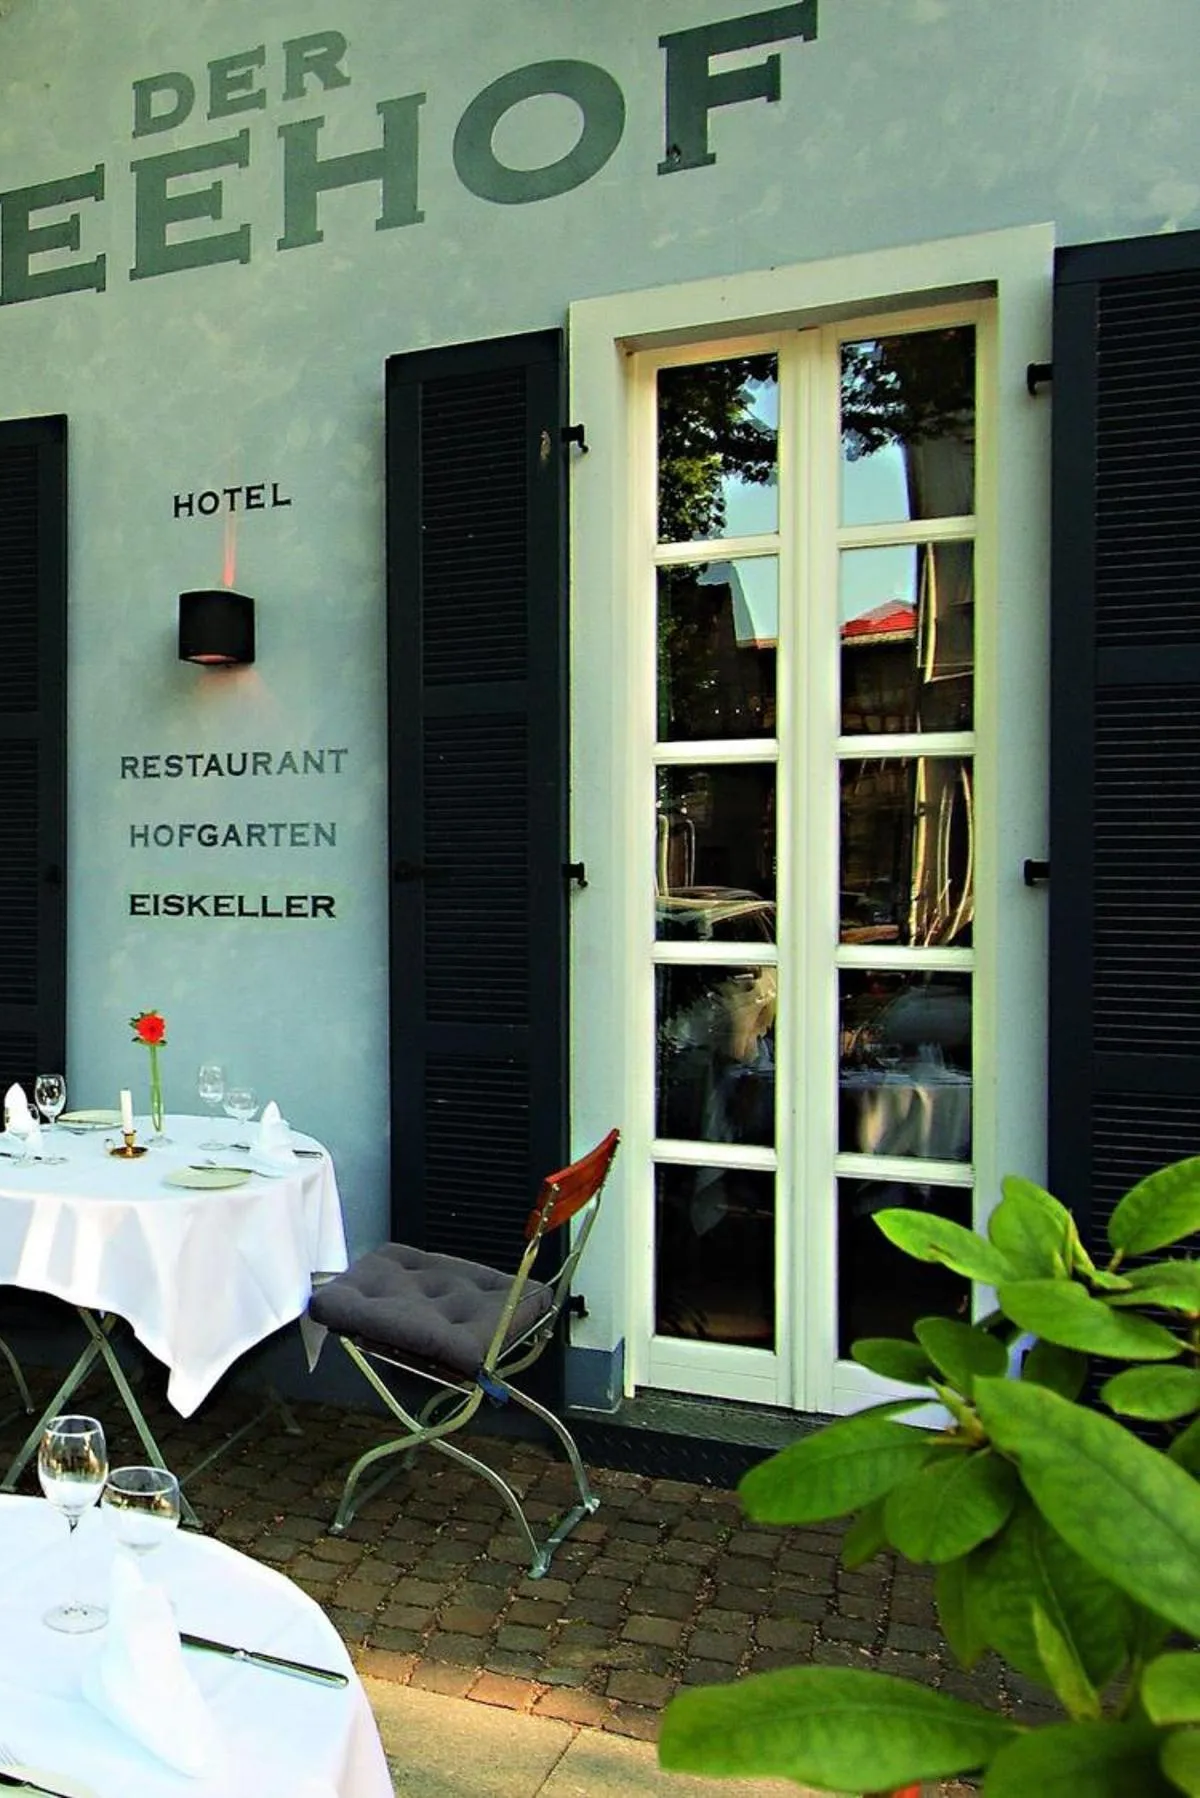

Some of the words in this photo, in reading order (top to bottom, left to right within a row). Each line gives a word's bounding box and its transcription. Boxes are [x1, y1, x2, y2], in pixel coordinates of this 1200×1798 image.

[131, 30, 351, 138] DER
[173, 483, 292, 518] HOTEL
[120, 748, 349, 779] RESTAURANT
[129, 822, 337, 848] HOFGARTEN
[129, 894, 337, 919] EISKELLER
